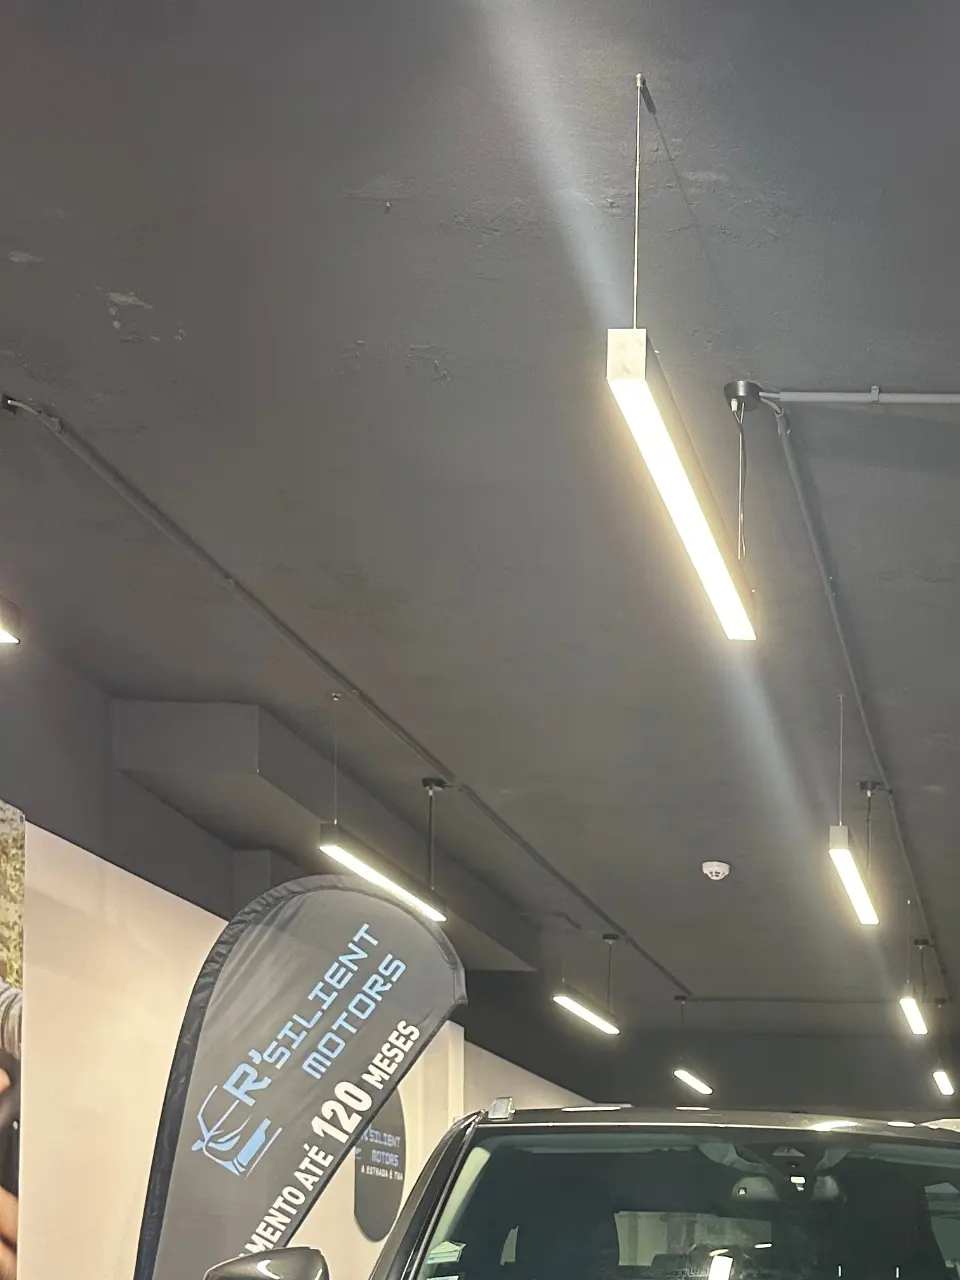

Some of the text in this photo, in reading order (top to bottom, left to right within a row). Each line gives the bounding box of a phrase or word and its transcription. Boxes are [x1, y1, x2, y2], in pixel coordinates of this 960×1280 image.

[223, 923, 379, 1106] R'SILIENT
[302, 953, 406, 1080] MOTORS
[362, 1020, 420, 1090] MESES
[311, 1081, 372, 1143] 120
[293, 1144, 334, 1191] ATÉ
